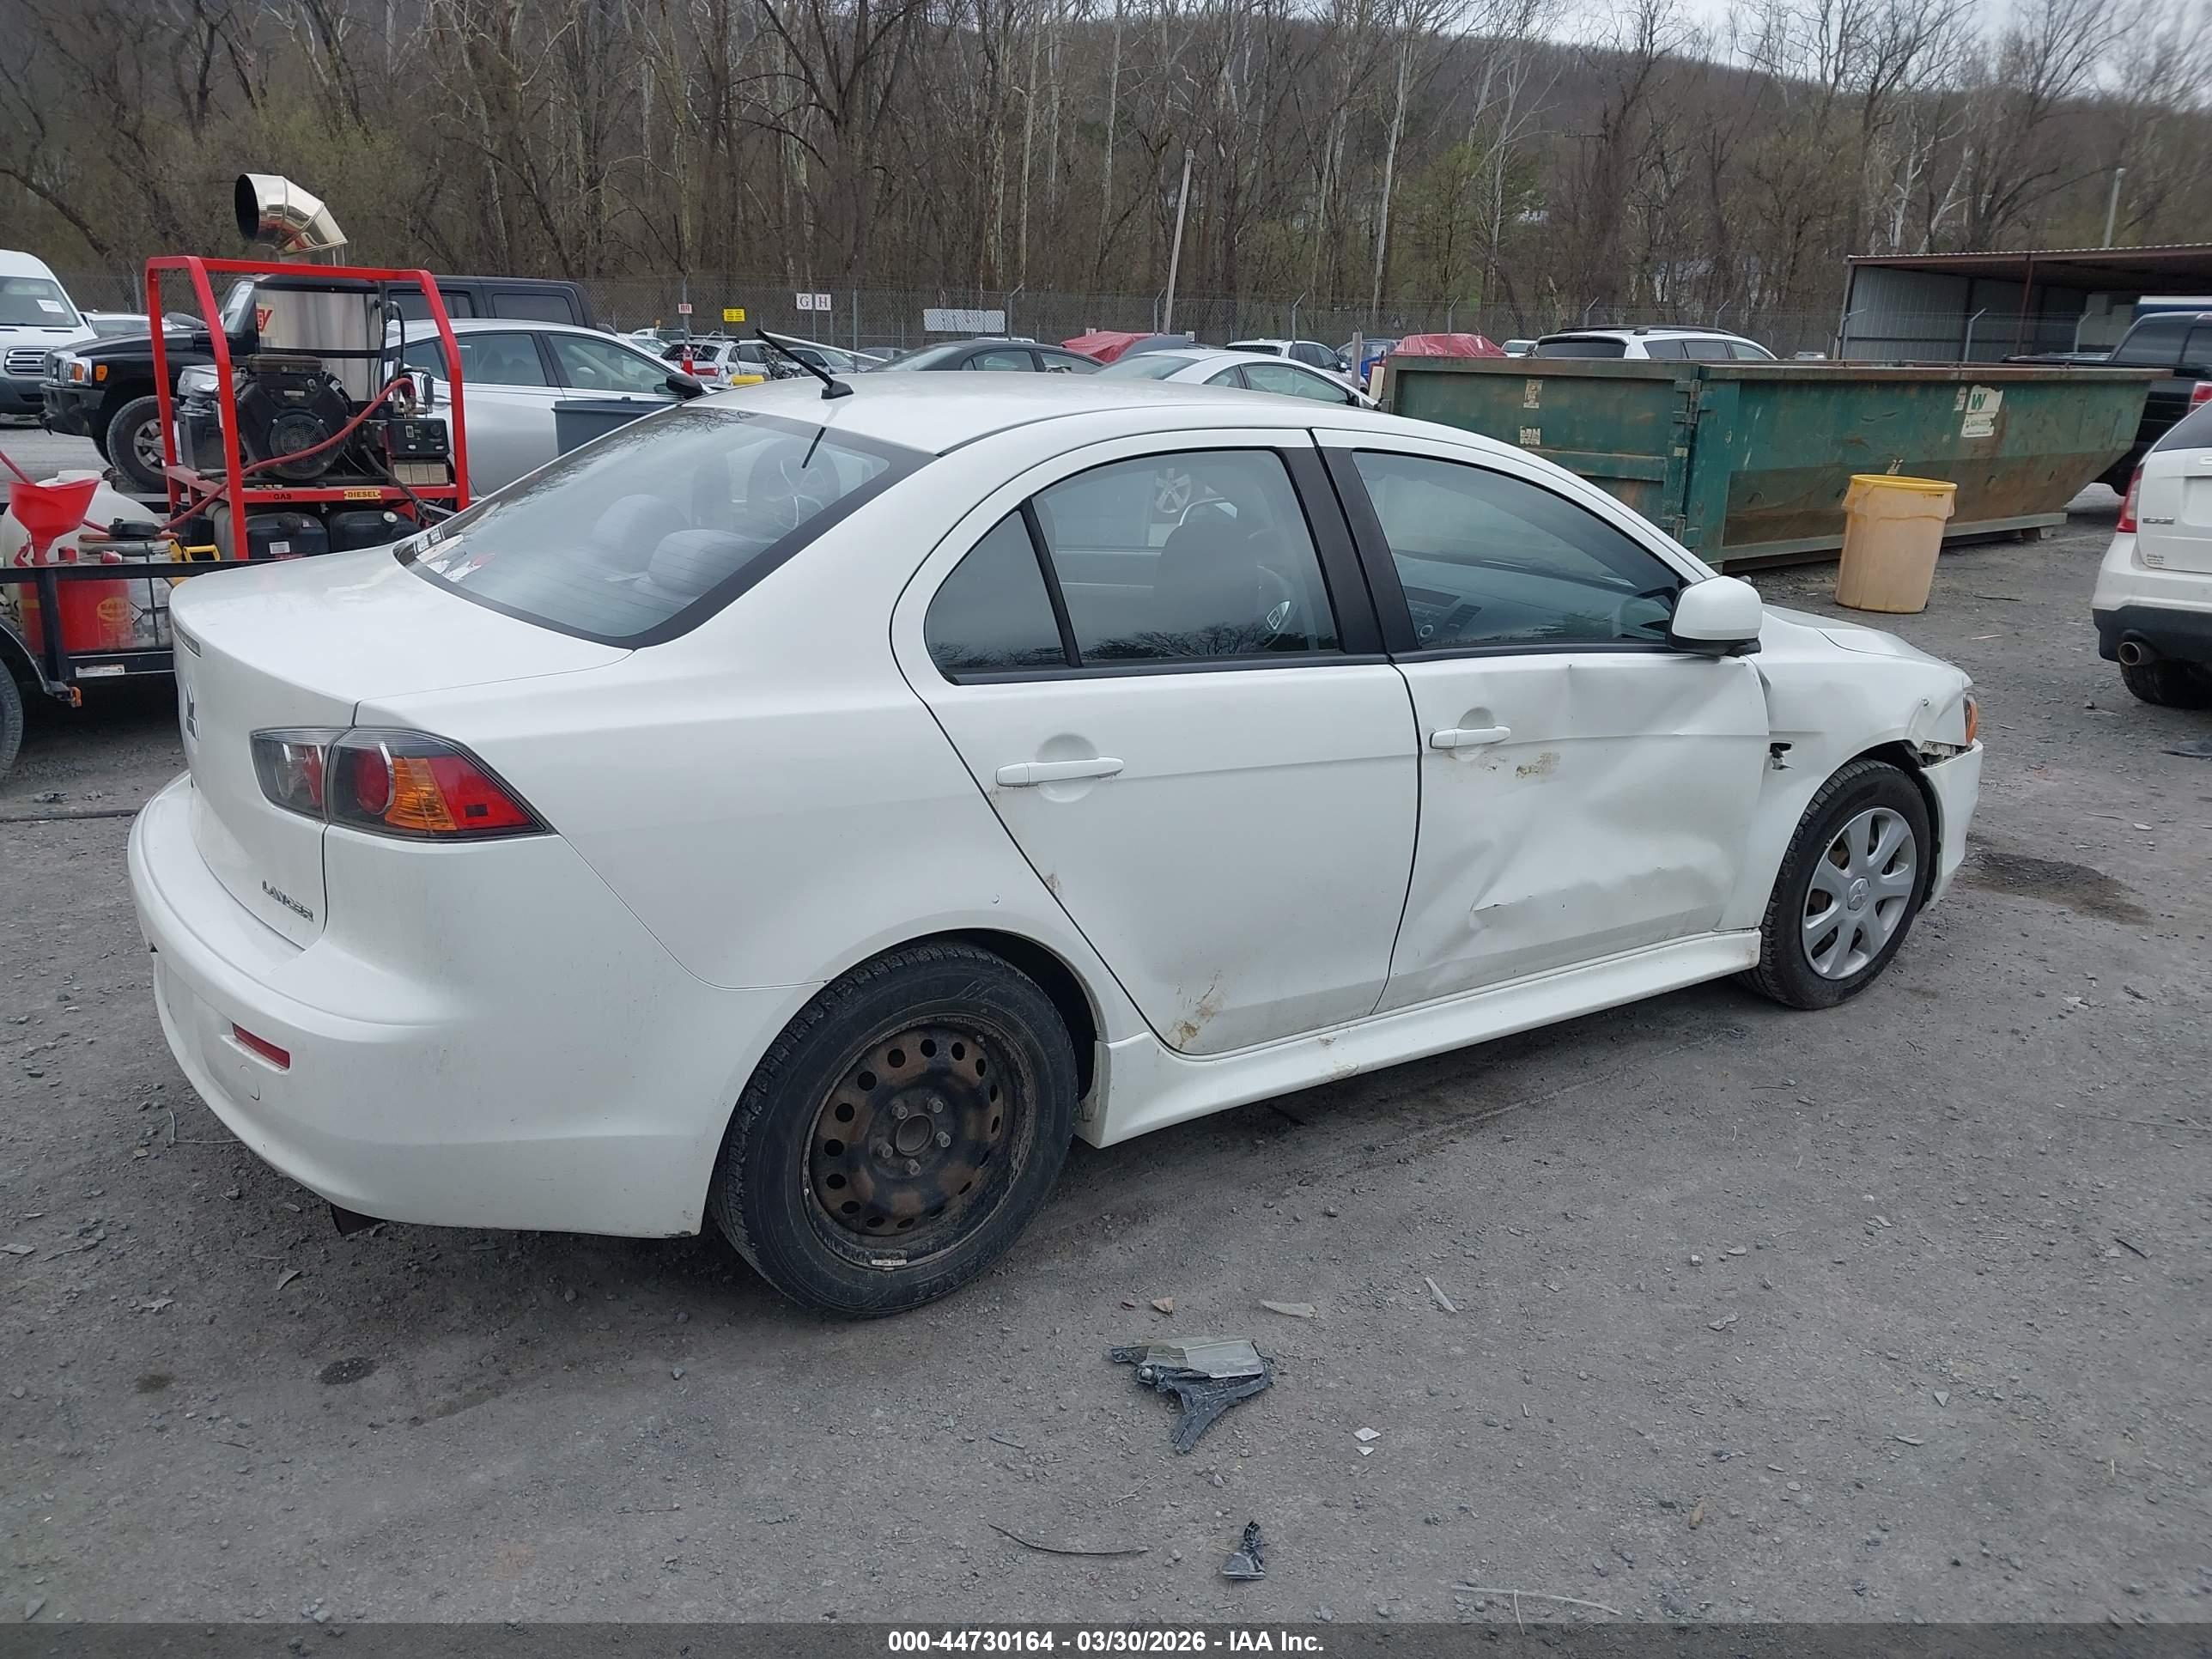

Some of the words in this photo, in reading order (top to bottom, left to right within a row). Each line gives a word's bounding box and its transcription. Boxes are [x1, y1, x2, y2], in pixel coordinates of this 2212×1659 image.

[799, 295, 810, 307] G
[818, 297, 827, 308] H
[262, 879, 314, 922] LANCER
